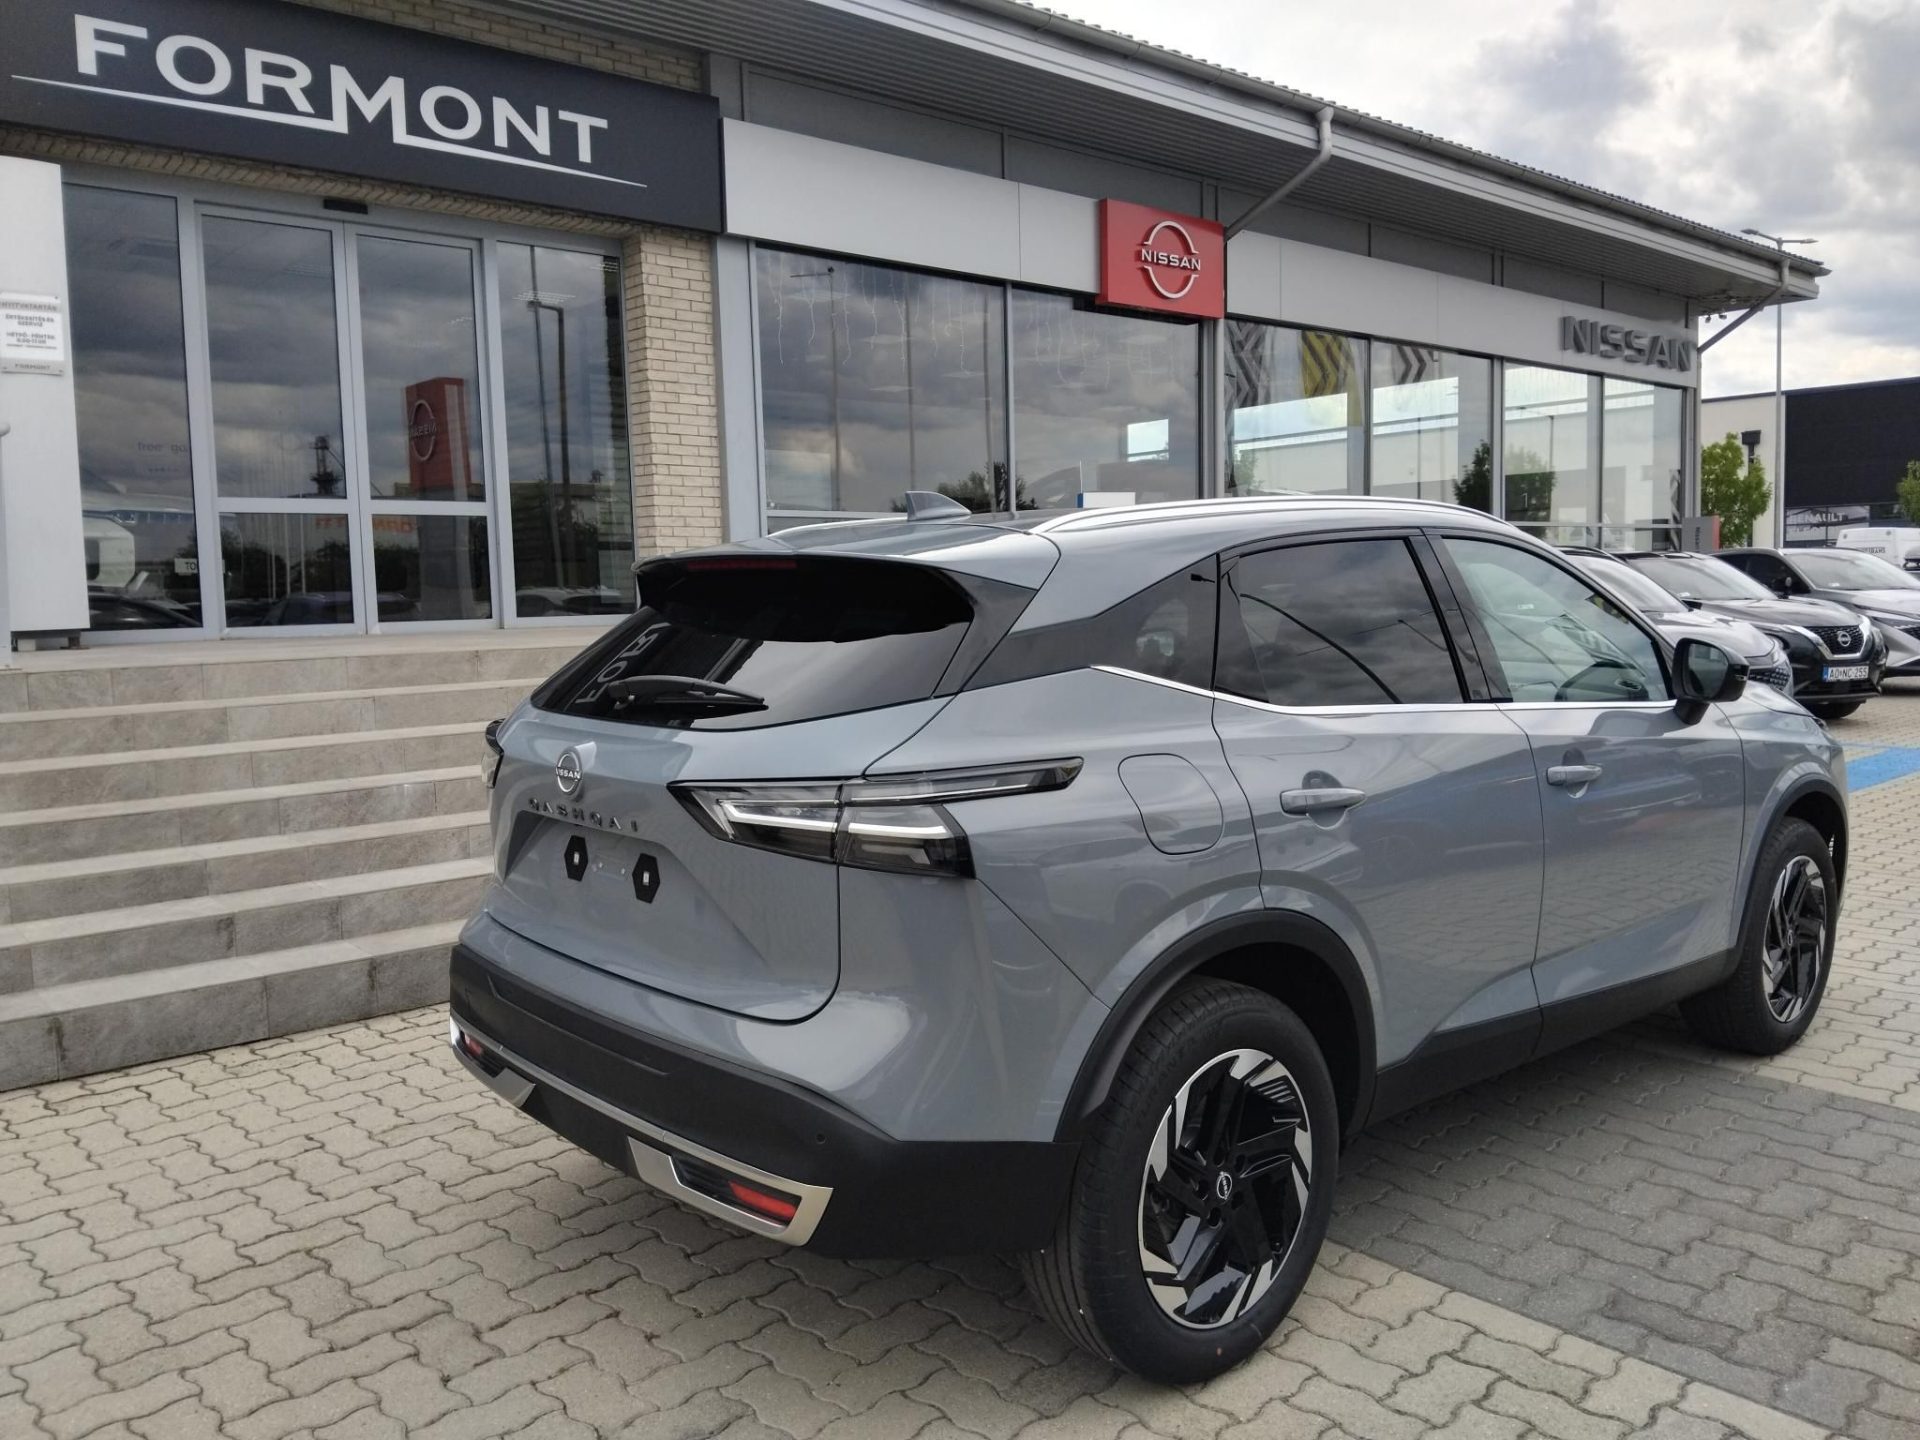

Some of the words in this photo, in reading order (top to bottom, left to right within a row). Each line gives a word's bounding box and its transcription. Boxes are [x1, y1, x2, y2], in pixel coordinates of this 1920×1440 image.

[74, 14, 608, 163] FORMONT
[1141, 248, 1201, 271] NISSAN
[1560, 316, 1697, 372] NISSAN
[529, 798, 638, 832] QASHQAI
